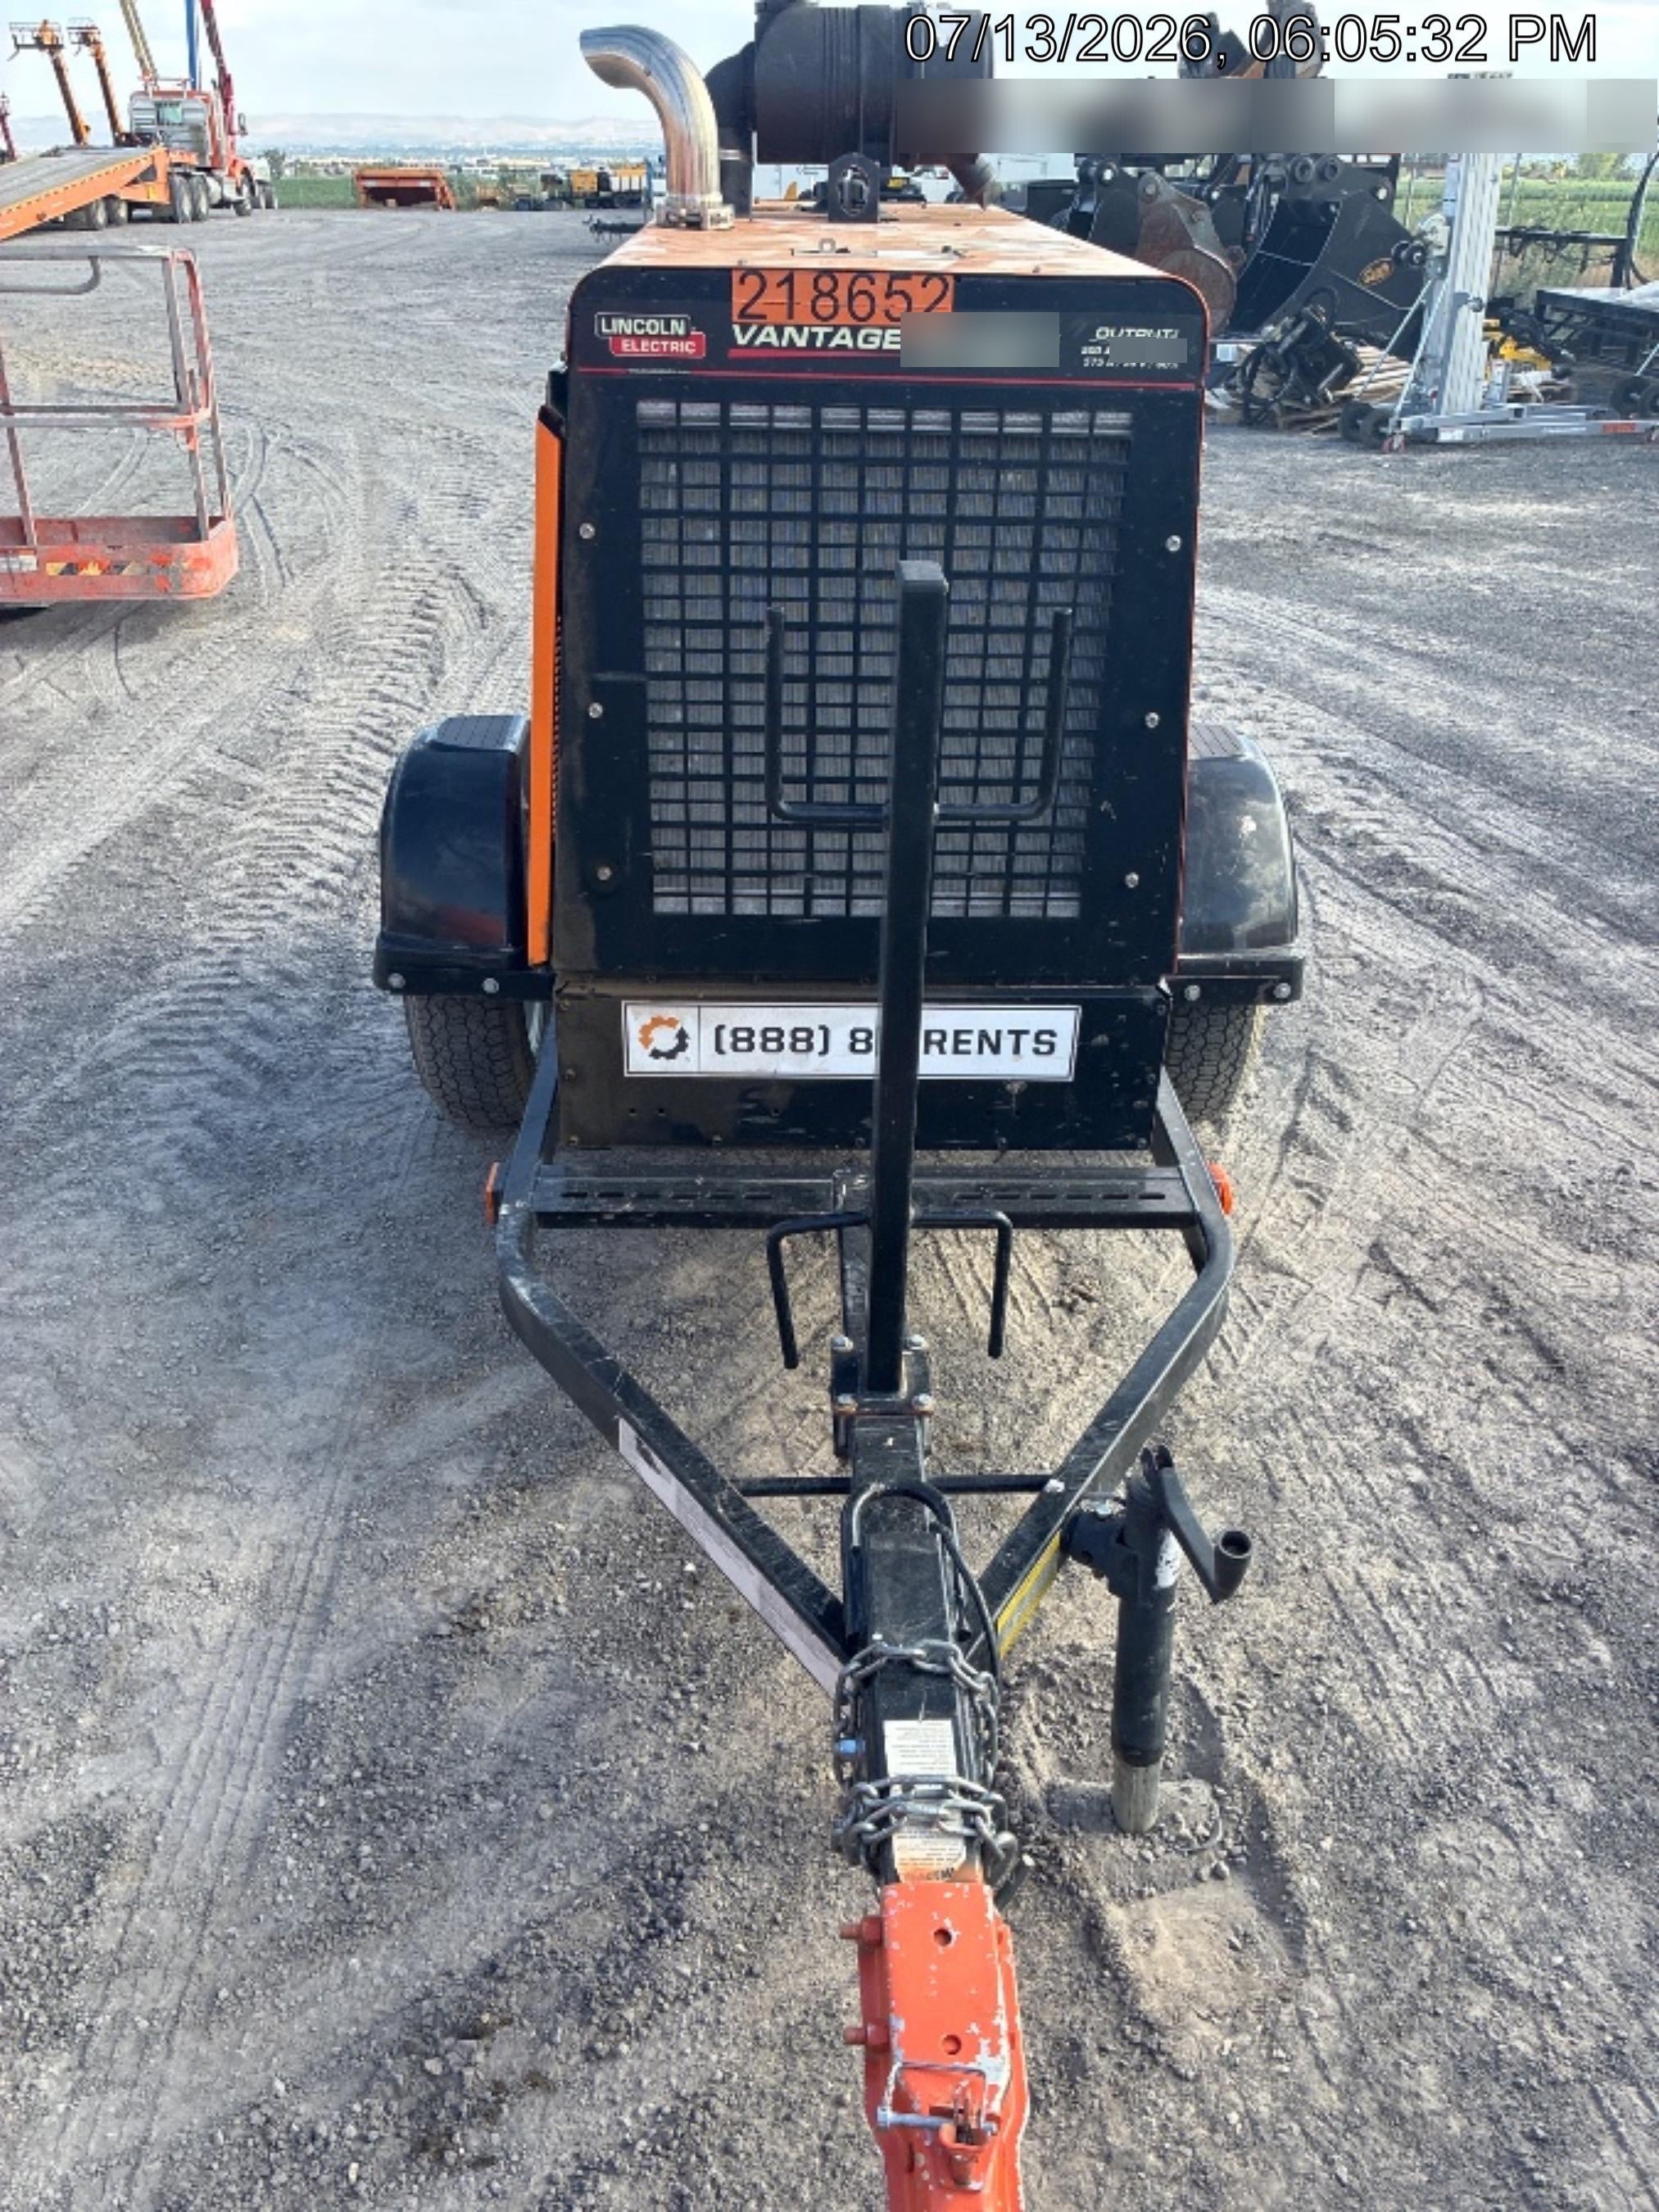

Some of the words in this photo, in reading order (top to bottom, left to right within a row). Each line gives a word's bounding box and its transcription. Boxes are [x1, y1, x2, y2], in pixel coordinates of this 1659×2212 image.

[737, 271, 950, 321] 218652
[601, 317, 685, 335] LINCOLN
[732, 324, 900, 350] VANTAGE
[622, 338, 696, 353] ELECTRIC
[714, 1025, 830, 1054] (888)
[849, 1027, 877, 1054] 8
[923, 1029, 1058, 1055] RENTS
